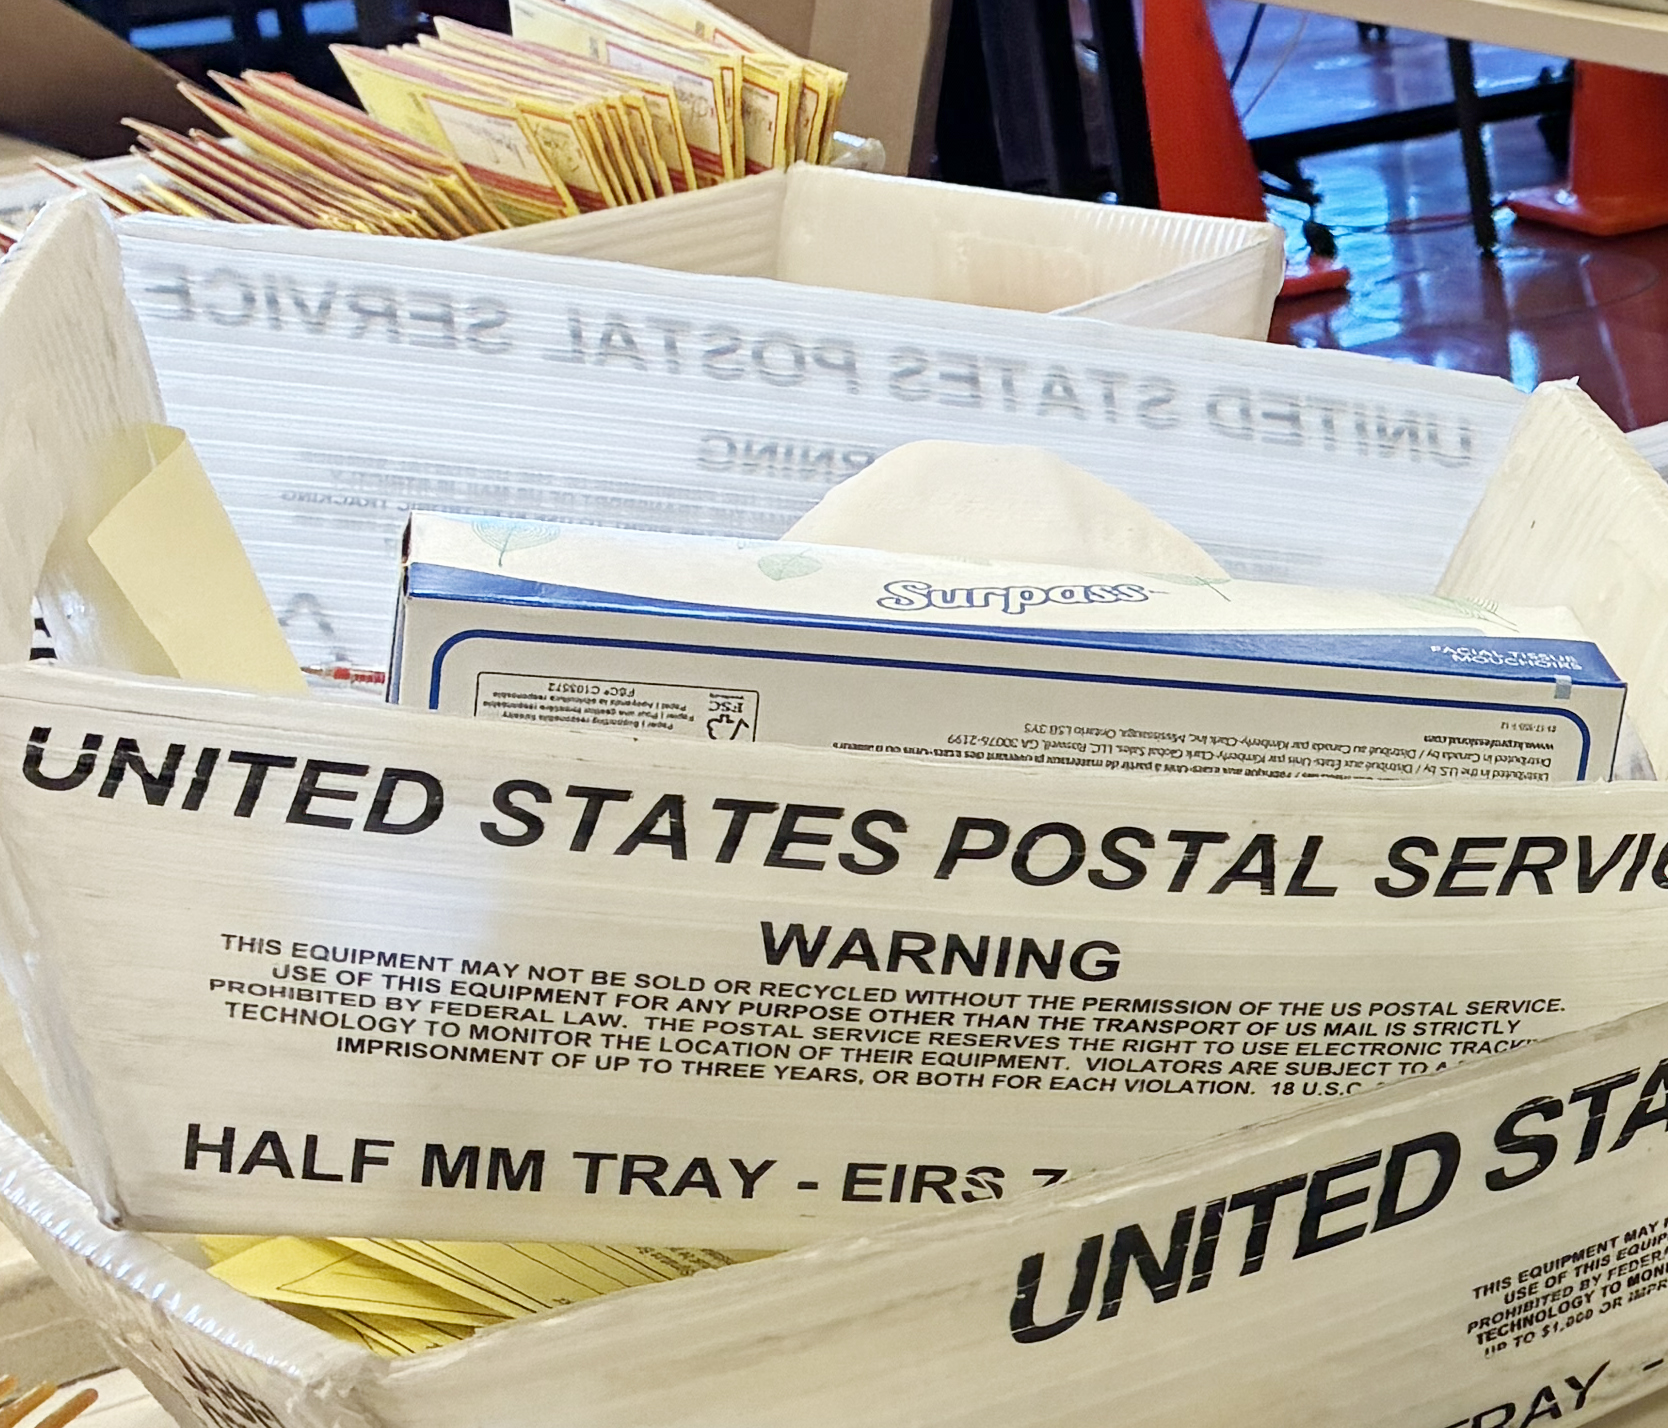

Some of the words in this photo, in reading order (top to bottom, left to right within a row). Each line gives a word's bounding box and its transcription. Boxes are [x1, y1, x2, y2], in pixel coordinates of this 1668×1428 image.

[877, 580, 1149, 615] Surpass
[22, 726, 446, 835] UNITED
[480, 778, 909, 880] STATES
[934, 816, 1341, 898] POSTAL
[220, 932, 282, 956] THIS
[291, 941, 454, 973] EQUIPMENT
[460, 958, 520, 979] MAY
[527, 964, 585, 984] NOT
[590, 970, 627, 988] BE
[633, 972, 706, 992] SOLD
[713, 978, 752, 996] OR
[758, 981, 897, 1003] RECYCLED
[904, 988, 1022, 1009] WITHOUT
[1026, 993, 1076, 1011] THE
[1081, 996, 1233, 1015] PERMISSION
[1238, 1000, 1273, 1016] OF
[1278, 1001, 1325, 1017] THE
[1330, 1001, 1362, 1017] US
[1367, 1001, 1458, 1017] POSTAL
[1465, 997, 1563, 1016] SERVICE.
[760, 921, 1122, 982] WARNING
[209, 978, 376, 1009] PROHIBITED
[385, 996, 422, 1012] BY
[429, 1000, 555, 1024] FEDERAL
[562, 1010, 628, 1029] LAW.
[643, 1015, 695, 1033] THE
[702, 1019, 804, 1039] POSTAL
[811, 1025, 921, 1045] SERVICE
[927, 1031, 1061, 1050] RESERVES
[1067, 1036, 1116, 1052] THE
[1121, 1038, 1198, 1054] RIGHT
[1202, 1040, 1235, 1055] TO
[1241, 1040, 1290, 1056] USE
[1294, 1041, 1442, 1057] ELECTRONIC
[224, 1000, 417, 1035] TECHNOLOGY
[424, 1019, 461, 1038] TO
[468, 1023, 592, 1048] MONITOR
[599, 1032, 651, 1052] THE
[658, 1036, 791, 1059] LOCATION
[798, 1044, 834, 1061] OF
[839, 1046, 914, 1065] THEIR
[920, 1050, 1070, 1071] EQUIPMENT.
[1085, 1056, 1223, 1075] VIOLATORS
[1227, 1060, 1279, 1076] ARE
[1283, 1061, 1393, 1077] SUBJECT
[1397, 1061, 1429, 1078] TO
[271, 963, 327, 984] USE
[335, 969, 373, 987] OF
[381, 973, 441, 994] THIS
[449, 979, 608, 1007] EQUIPMENT
[614, 992, 669, 1012] FOR
[675, 996, 732, 1015] ANY
[737, 1000, 862, 1022] PURPOSE
[868, 1007, 955, 1027] OTHER
[962, 1012, 1030, 1029] THAN
[1037, 1014, 1086, 1032] THE
[1092, 1016, 1242, 1036] TRANSPORT
[1245, 1021, 1280, 1037] OF
[1284, 1021, 1317, 1037] US
[1322, 1021, 1378, 1037] MAIL
[1384, 1021, 1407, 1037] IS
[1412, 1019, 1521, 1037] STRICTLY
[336, 1036, 544, 1067] IMPRISONMENT
[550, 1051, 587, 1069] OF
[594, 1054, 630, 1072] UP
[637, 1057, 673, 1074] TO
[680, 1059, 766, 1079] THREE
[773, 1064, 864, 1086] YEARS,
[871, 1068, 909, 1085] OR
[915, 1070, 985, 1088] BOTH
[991, 1073, 1042, 1090] FOR
[1048, 1075, 1117, 1092] EACH
[1124, 1077, 1255, 1095] VIOLATION.
[1271, 1081, 1295, 1096] 18
[182, 1123, 396, 1185] HALF
[422, 1144, 546, 1193] MM
[573, 1152, 776, 1201] TRAY
[797, 1181, 819, 1190] -
[842, 1163, 1003, 1204] EIRS
[1009, 1130, 1462, 1346] UNITED
[1446, 1360, 1611, 1428] RAY
[1643, 1357, 1664, 1372] -
